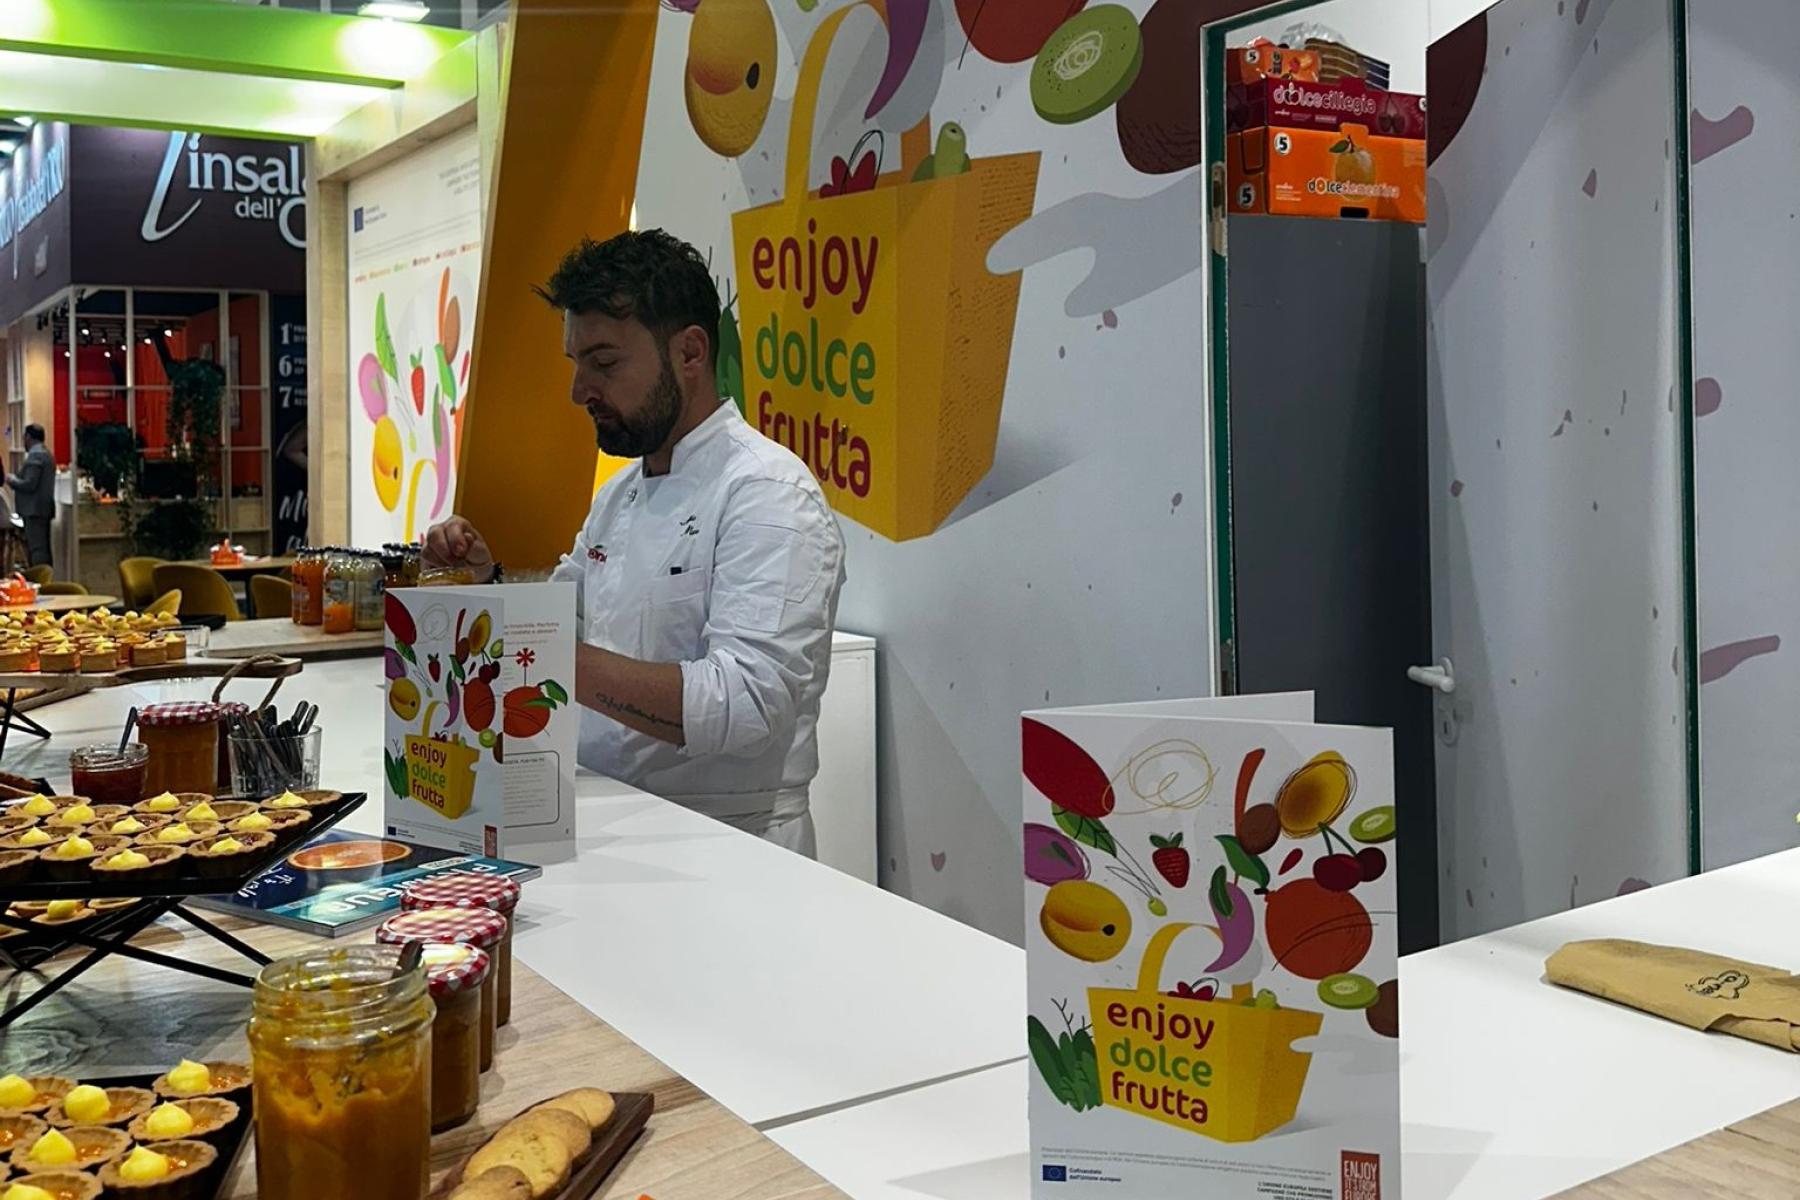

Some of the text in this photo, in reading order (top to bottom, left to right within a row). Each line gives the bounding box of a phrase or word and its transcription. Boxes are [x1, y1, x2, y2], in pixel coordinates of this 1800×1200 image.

[753, 218, 878, 314] enjoy
[279, 355, 292, 377] 6
[757, 312, 876, 404] dolce
[279, 386, 292, 408] 7
[411, 741, 447, 767] enjoy
[412, 762, 446, 788] dolce
[412, 779, 445, 808] frutta
[1107, 1003, 1215, 1050] enjoy
[1110, 1037, 1213, 1087] dolce
[1112, 1071, 1209, 1124] frutta
[1343, 1159, 1378, 1180] ENJOY
